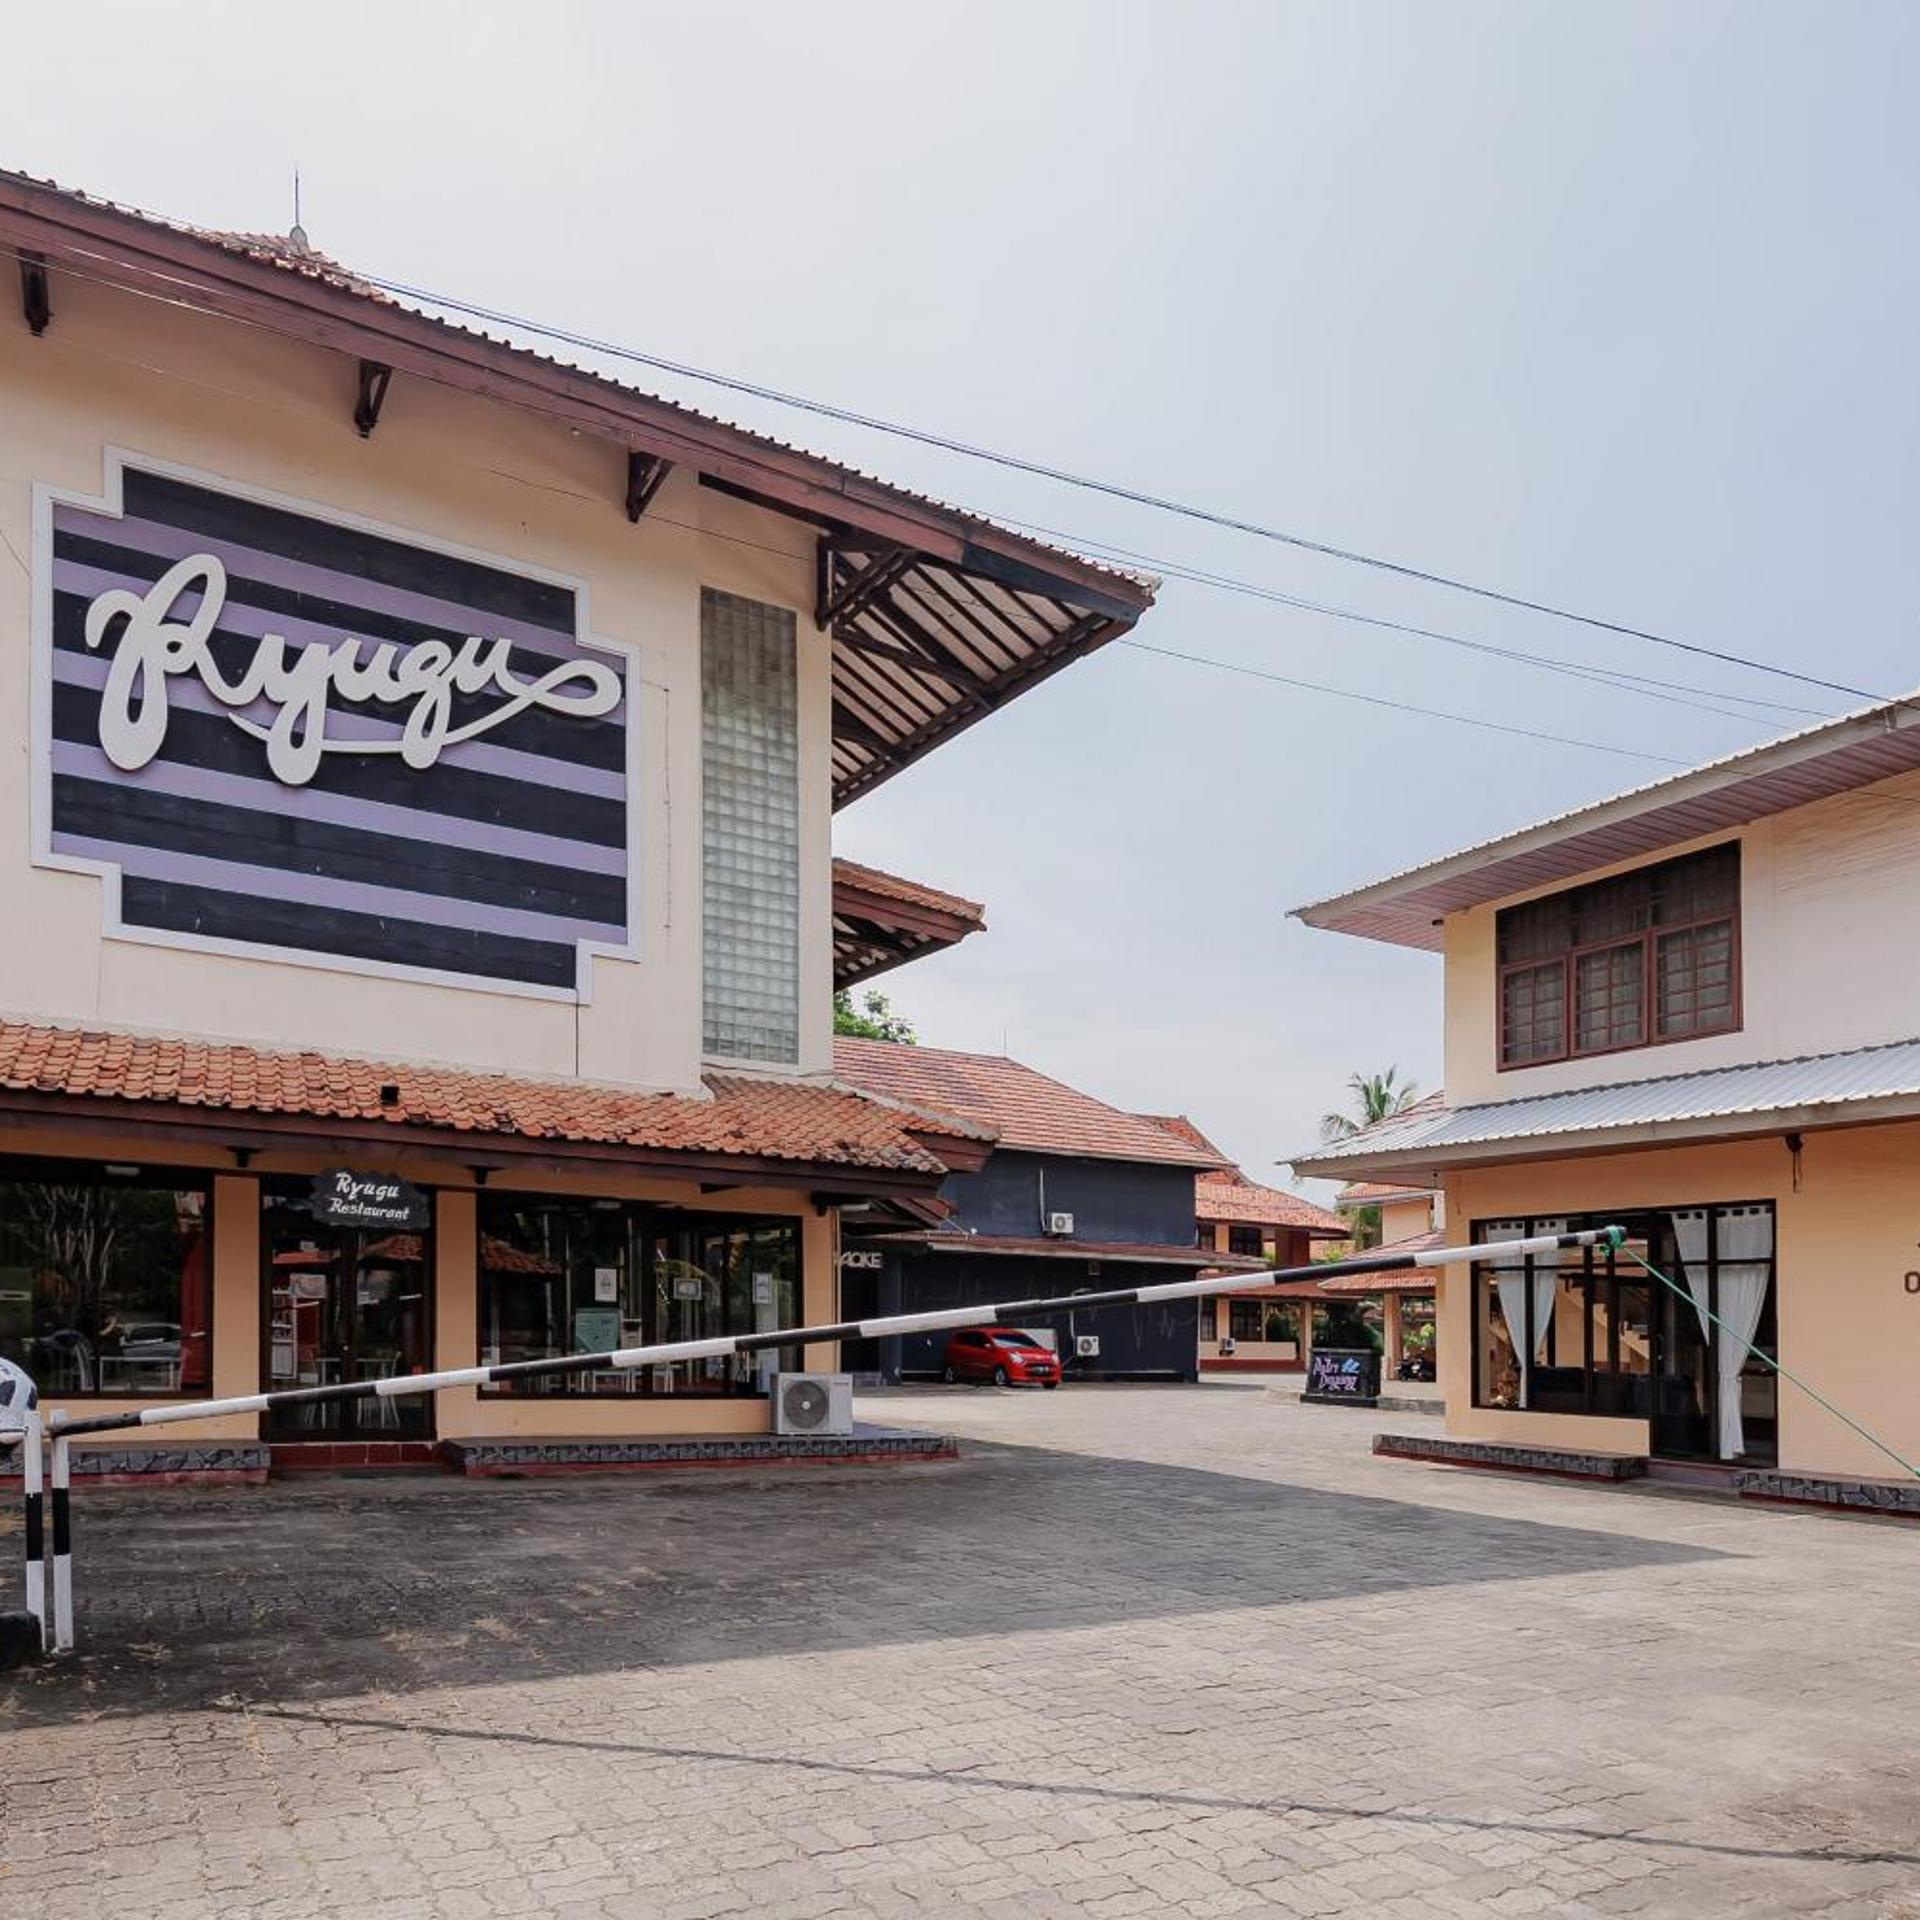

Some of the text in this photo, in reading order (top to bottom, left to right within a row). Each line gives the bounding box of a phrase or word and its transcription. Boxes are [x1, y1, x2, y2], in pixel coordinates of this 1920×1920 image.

[85, 554, 622, 785] Ryugu
[336, 1171, 400, 1201] Ryugu
[328, 1197, 410, 1220] Restaurant
